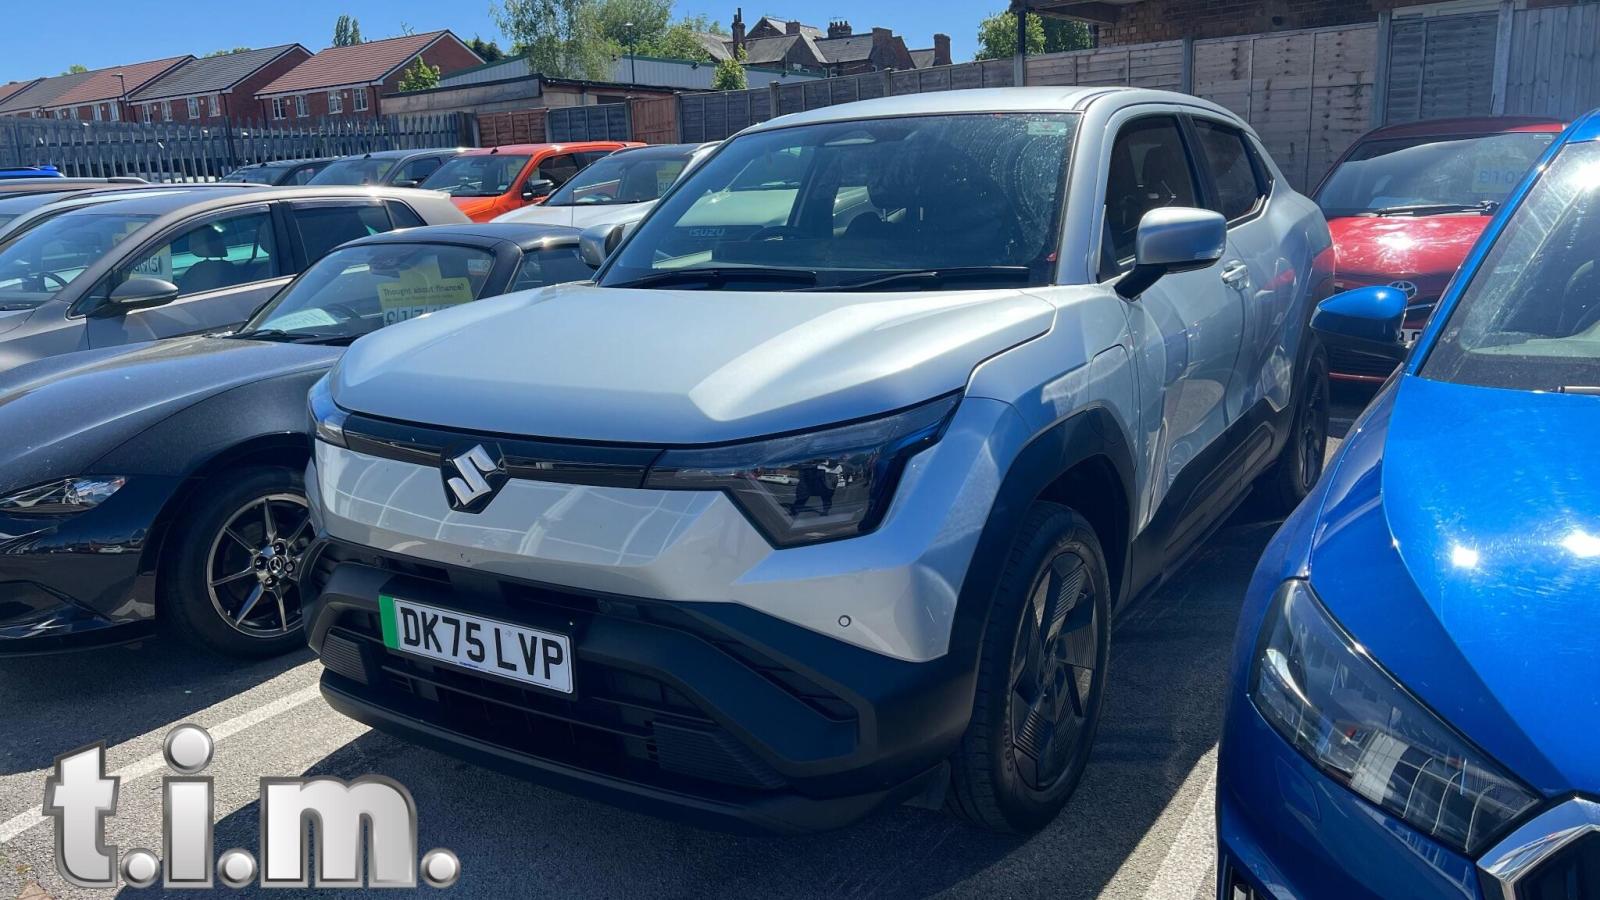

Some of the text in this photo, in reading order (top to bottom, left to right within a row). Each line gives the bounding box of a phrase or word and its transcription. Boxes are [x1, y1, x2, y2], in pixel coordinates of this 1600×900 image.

[688, 228, 726, 237] ISUZU
[383, 282, 465, 297] Thought about finance?
[401, 606, 563, 680] DK75 LVP
